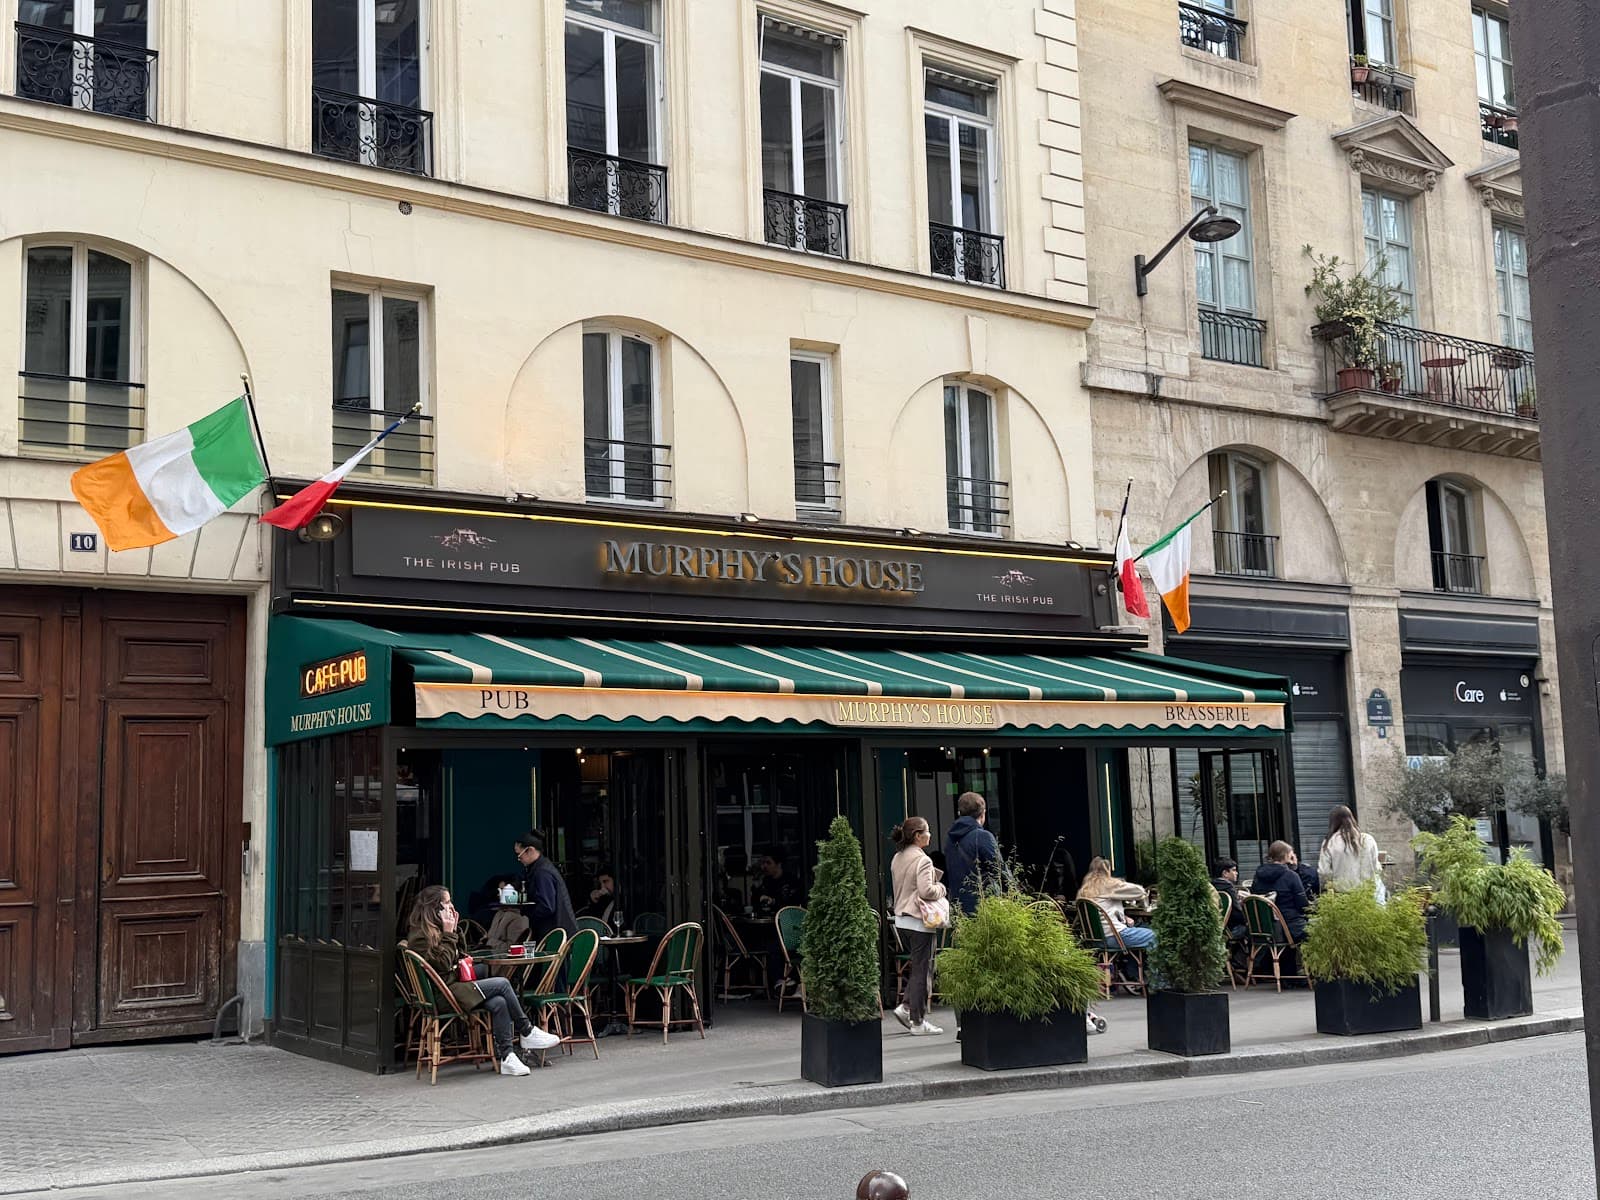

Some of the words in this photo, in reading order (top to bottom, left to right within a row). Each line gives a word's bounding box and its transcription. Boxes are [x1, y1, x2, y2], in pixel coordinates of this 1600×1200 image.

[74, 535, 93, 550] 10
[403, 556, 435, 568] THE
[441, 559, 483, 571] IRISH
[490, 562, 520, 573] PUB
[605, 540, 803, 584] MURPHY'S
[809, 555, 925, 592] HOUSE
[976, 593, 997, 602] THE
[1001, 595, 1029, 604] IRISH
[1033, 596, 1053, 605] PUB
[340, 656, 366, 684] PUB
[479, 689, 529, 709] PUB
[291, 708, 336, 732] MURPHY'S
[337, 702, 372, 725] HOUSE
[839, 701, 931, 724] MURPHY'S
[936, 703, 994, 725] HOUSE
[1165, 705, 1250, 721] BRASSERIE
